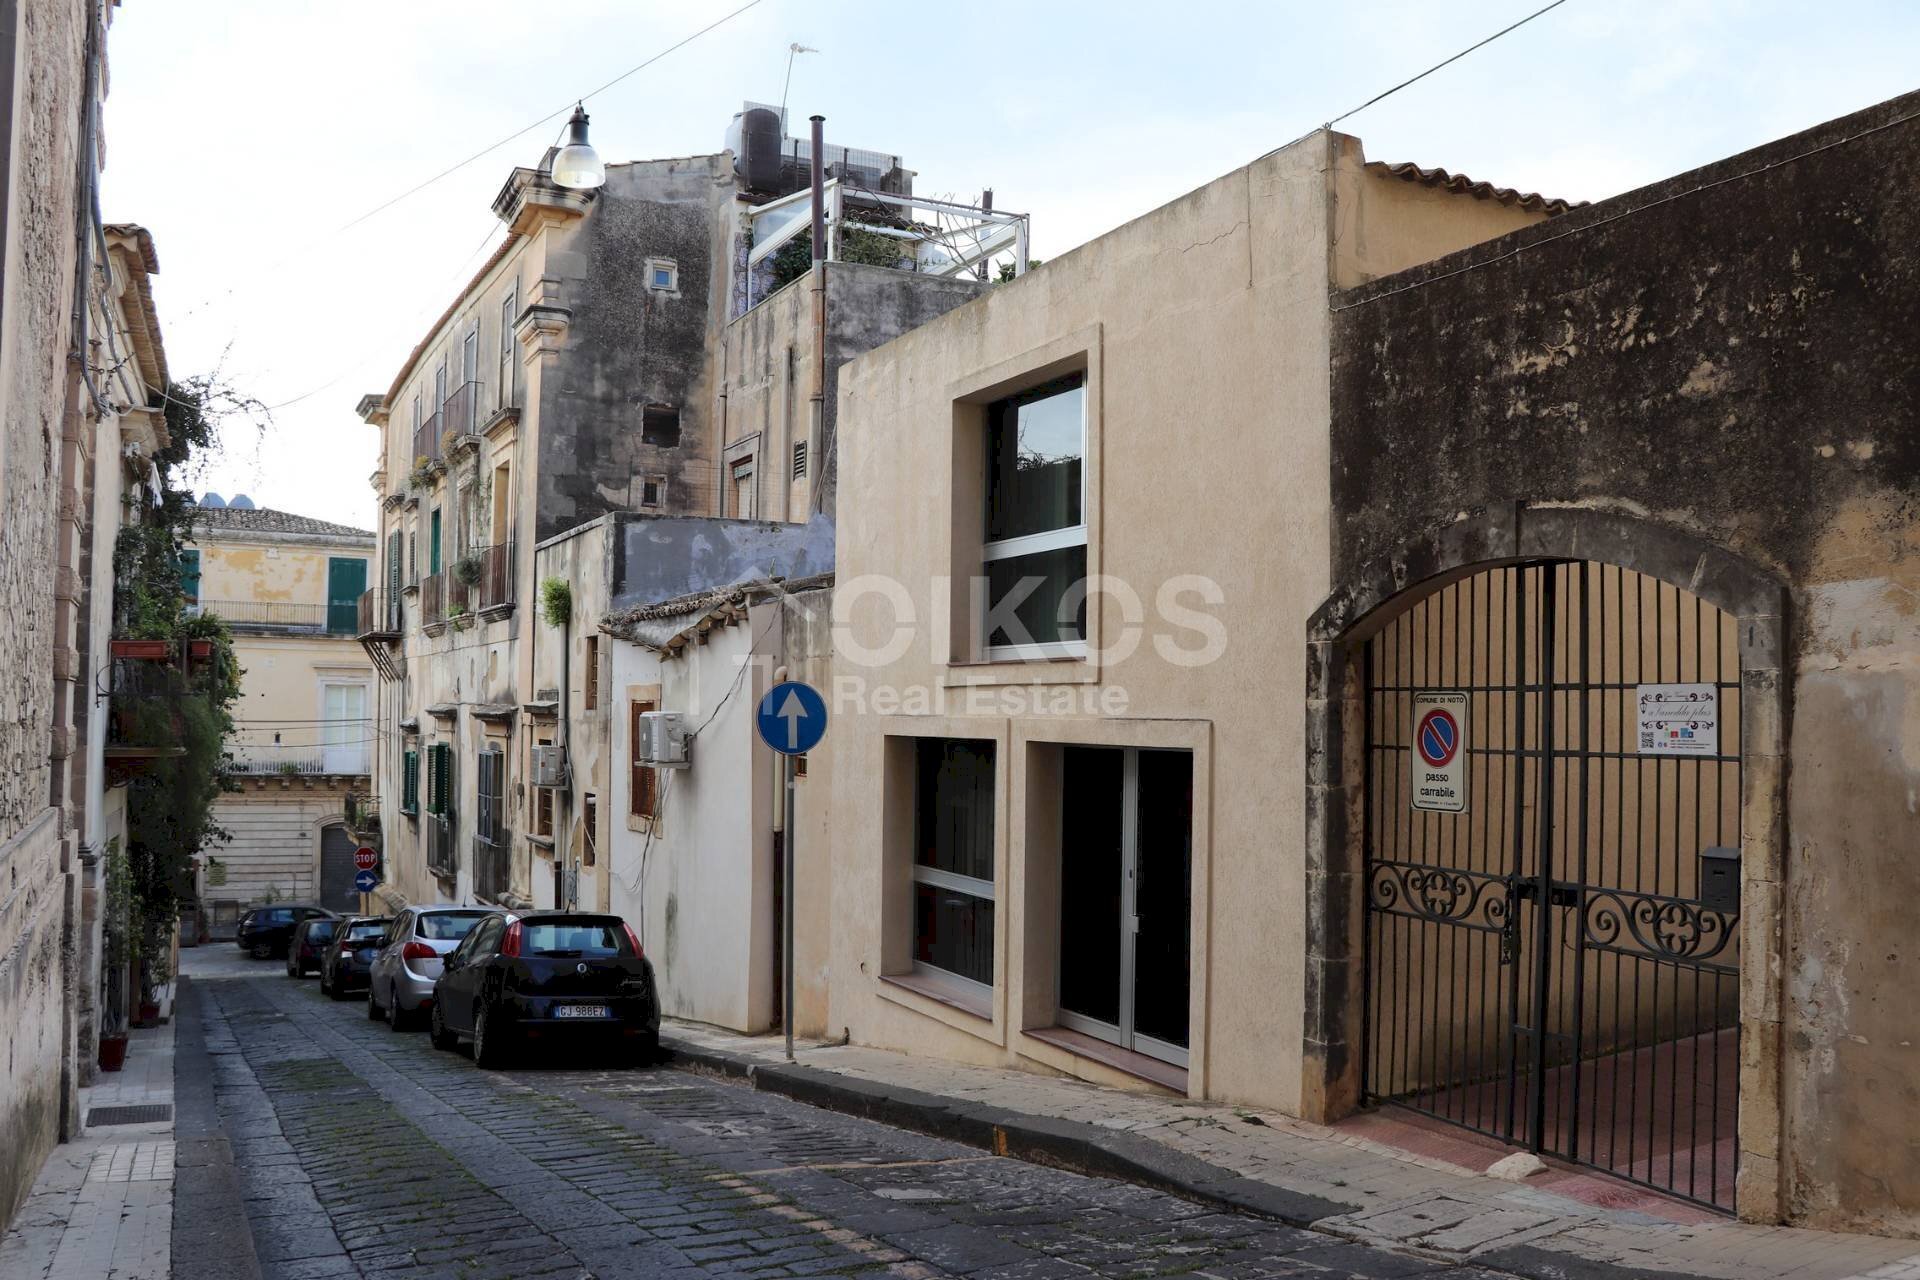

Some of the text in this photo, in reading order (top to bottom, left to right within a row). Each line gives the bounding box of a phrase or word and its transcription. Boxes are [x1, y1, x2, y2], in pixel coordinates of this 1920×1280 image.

[1447, 696, 1464, 704] NOTO
[1425, 772, 1449, 783] passo
[1420, 786, 1455, 798] carrabile
[355, 854, 375, 863] STOP
